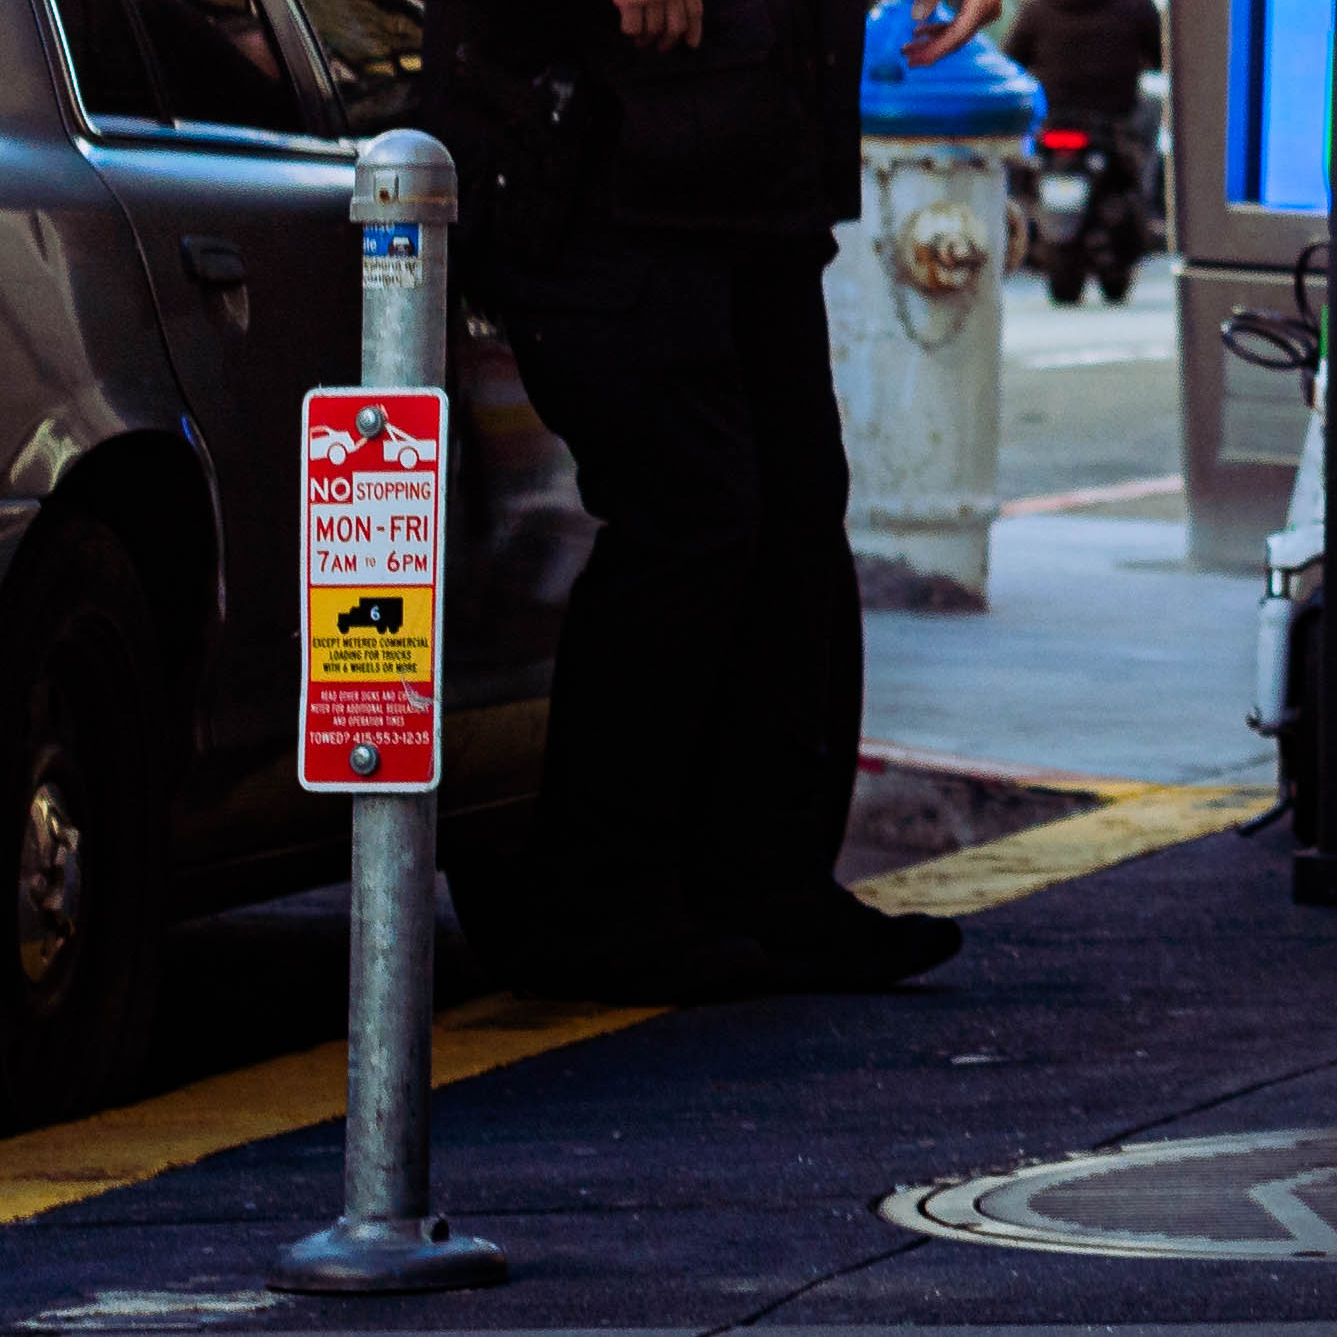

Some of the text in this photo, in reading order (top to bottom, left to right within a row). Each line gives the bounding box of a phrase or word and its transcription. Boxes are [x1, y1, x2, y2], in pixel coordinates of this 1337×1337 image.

[311, 477, 431, 502] NO STOPPING
[316, 550, 358, 573] 7AM
[386, 550, 428, 573] 6PM
[370, 606, 381, 621] 6
[312, 638, 340, 648] EXCEPT
[329, 650, 412, 661] LOADING FOR TRUCKS
[322, 662, 341, 673] WITH
[350, 662, 380, 673] WHEELS
[382, 662, 394, 673] OR
